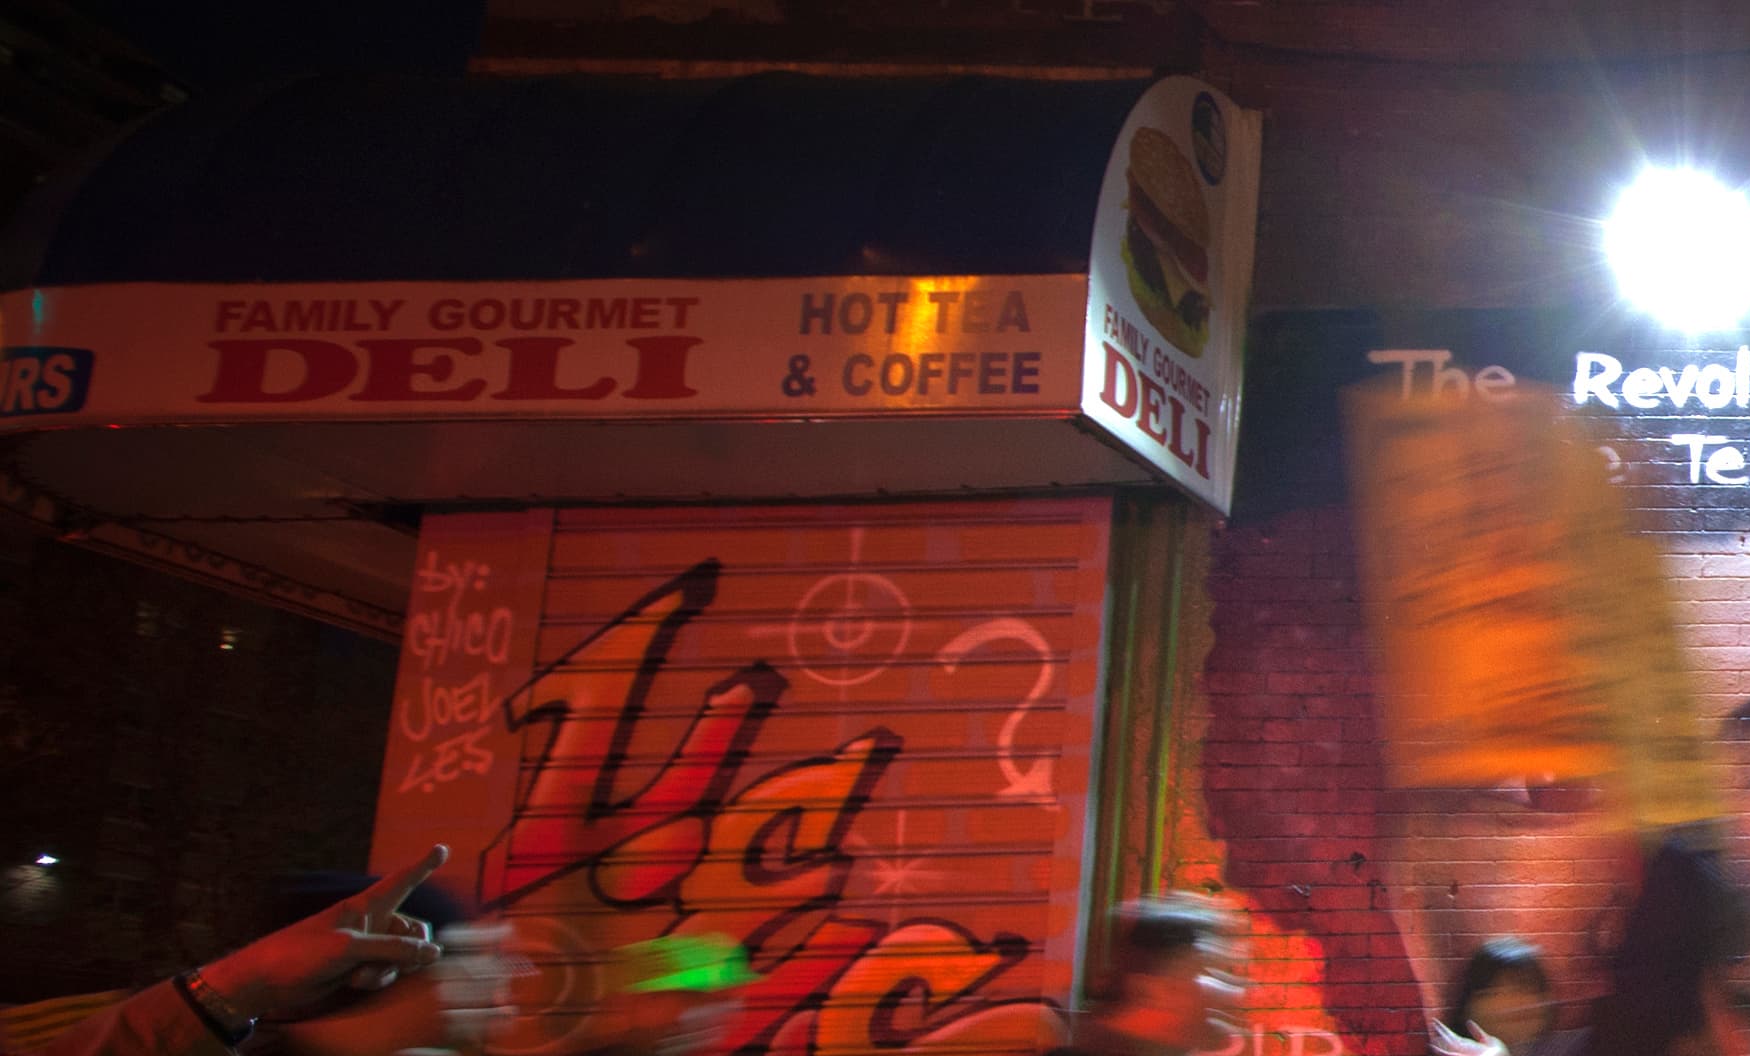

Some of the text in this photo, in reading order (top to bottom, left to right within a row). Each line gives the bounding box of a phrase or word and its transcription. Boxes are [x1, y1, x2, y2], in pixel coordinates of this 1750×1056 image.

[216, 297, 699, 333] FAMILY GOURMET
[799, 290, 1032, 335] HOT TEA
[196, 335, 703, 402] DELI
[781, 351, 1042, 398] & COFFEE
[1104, 303, 1211, 418] FAMILY GOURMET
[1367, 348, 1517, 402] The
[1099, 340, 1211, 481] DELI
